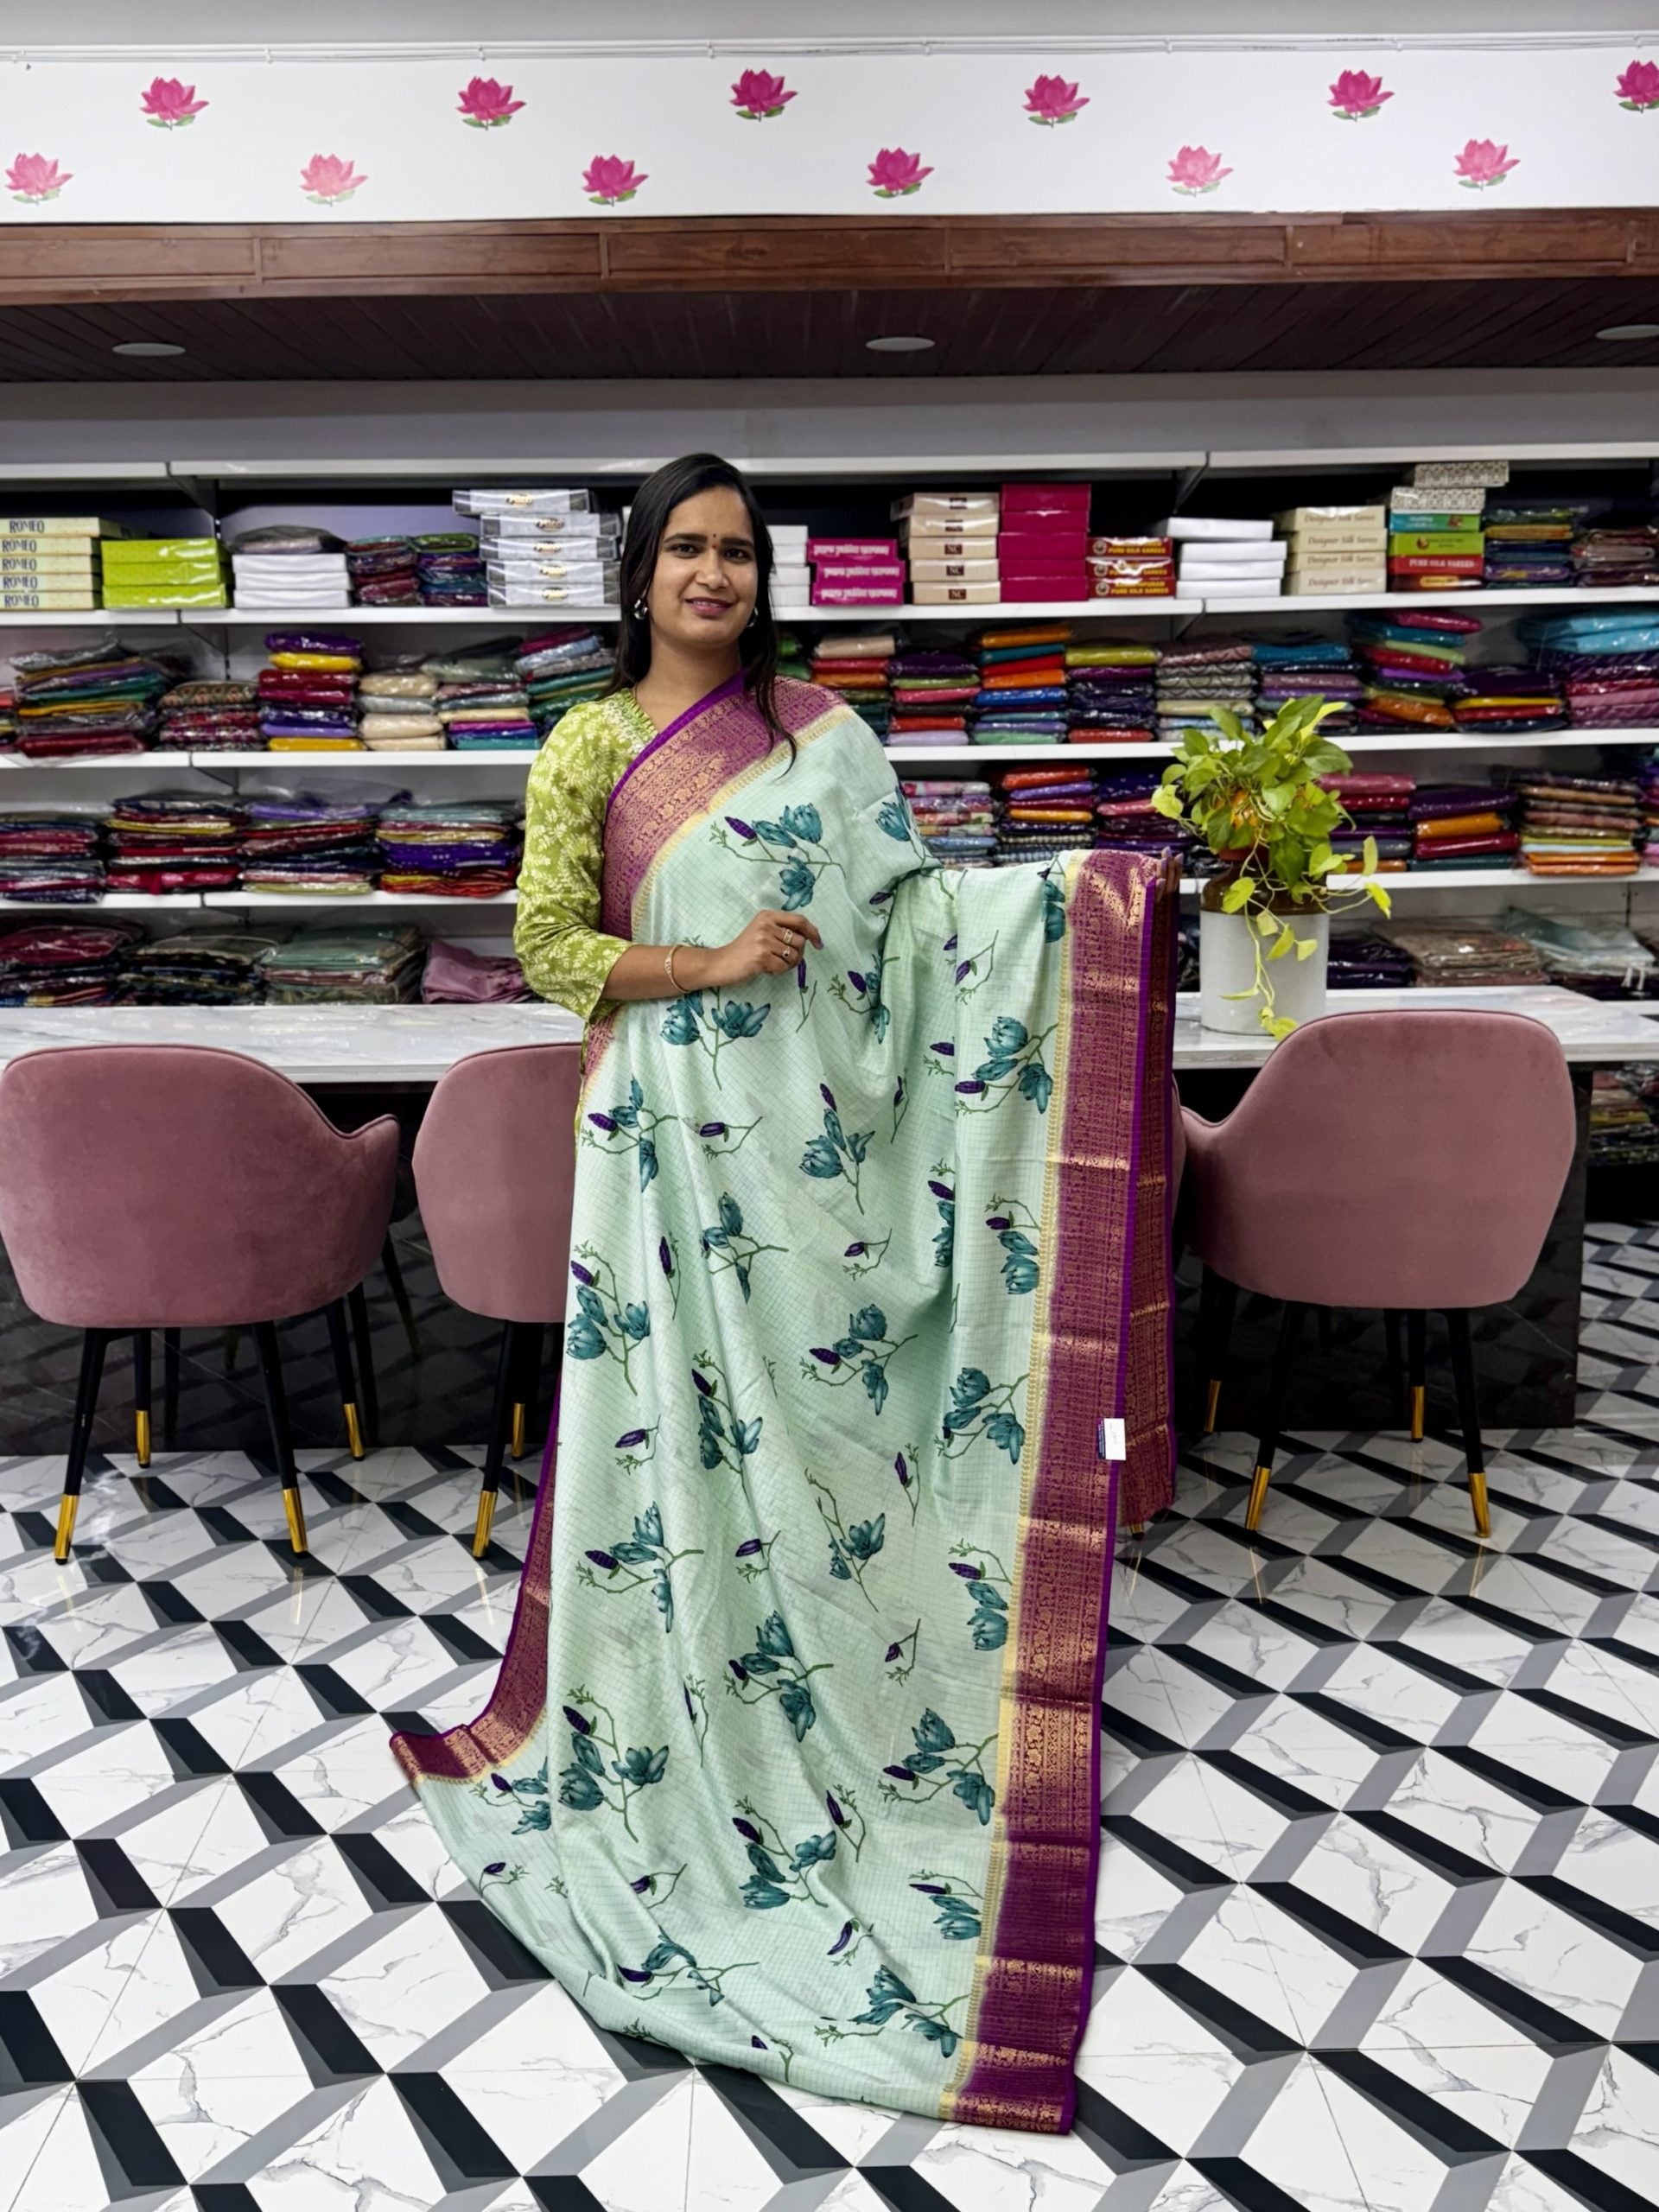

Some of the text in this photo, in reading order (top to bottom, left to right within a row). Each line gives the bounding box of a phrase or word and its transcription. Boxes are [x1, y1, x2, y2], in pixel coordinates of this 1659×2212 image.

[9, 519, 45, 533] ROMEO
[2, 539, 37, 553] ROMEO
[1307, 536, 1338, 547] Designer
[947, 544, 960, 553] NC
[2, 557, 37, 571] ROMEO
[949, 566, 962, 575] NC
[3, 576, 38, 589] ROMEO
[951, 589, 964, 598] NC
[4, 594, 40, 607] ROMEO
